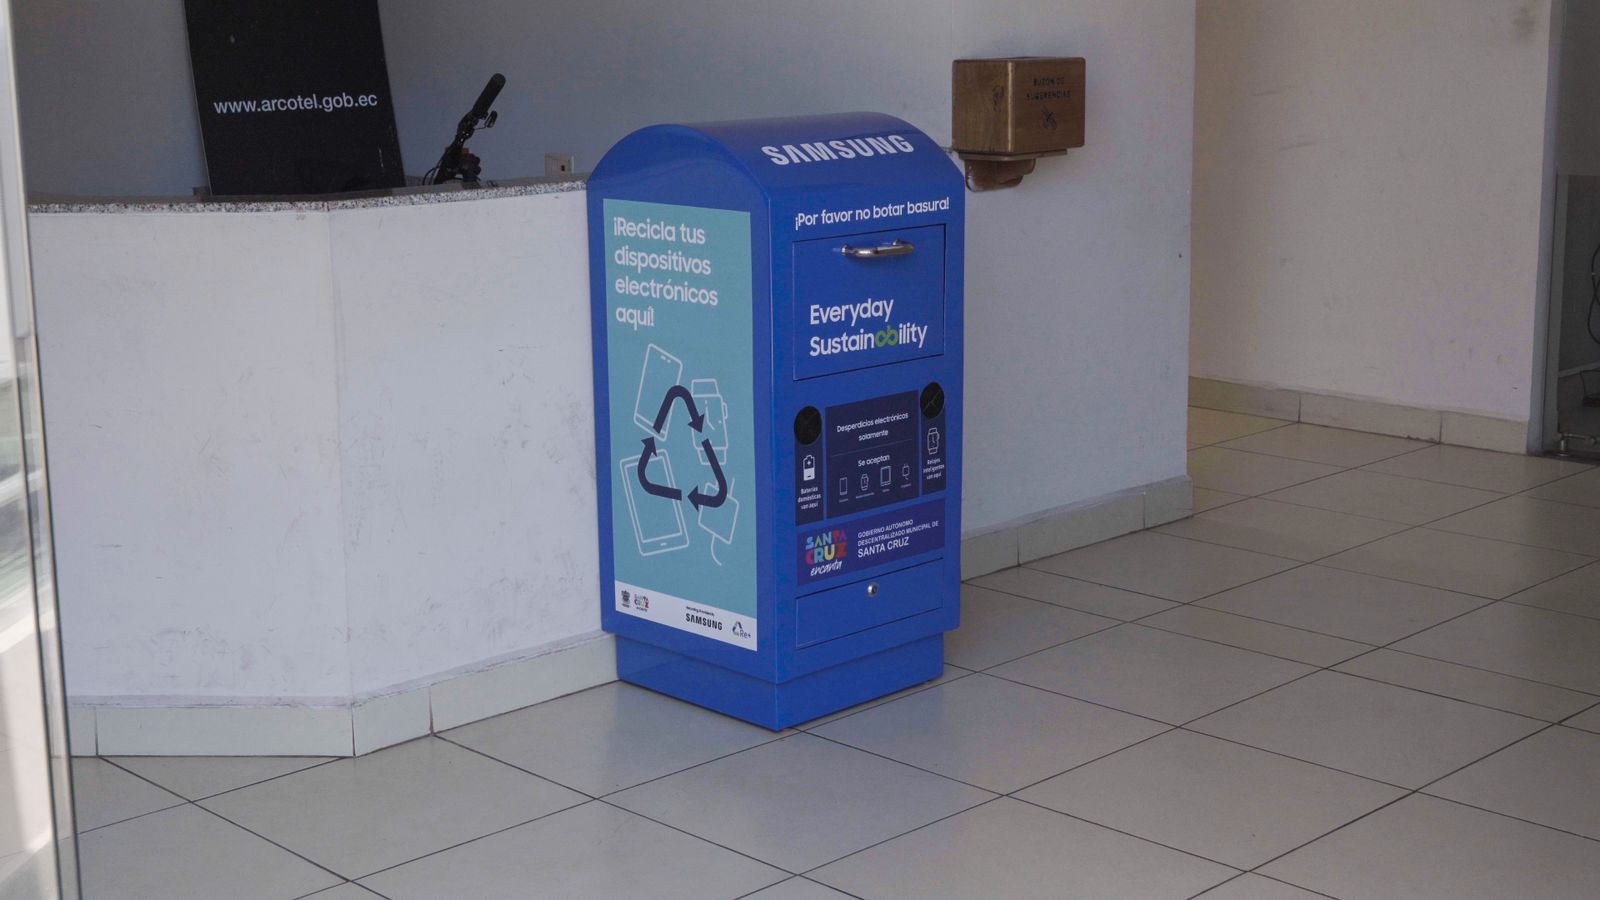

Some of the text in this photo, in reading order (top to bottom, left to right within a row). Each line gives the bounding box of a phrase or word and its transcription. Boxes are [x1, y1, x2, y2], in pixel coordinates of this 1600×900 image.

[213, 92, 378, 114] www.arcotel.gob.ec
[761, 134, 915, 166] SAMSUNG
[795, 197, 950, 231] ¡Por favor no botar basura!
[680, 223, 706, 245] tus
[614, 244, 712, 276] dispositivos
[615, 275, 719, 306] electrónicos
[615, 305, 655, 332] aquí!
[810, 298, 894, 327] Everyday
[809, 322, 928, 357] Sustainability
[836, 412, 909, 433] Desperdicios electrónicos
[858, 430, 889, 441] solamente
[866, 454, 891, 465] aceptan
[805, 529, 848, 550] SANTA
[857, 528, 885, 539] GOBIERNO
[857, 520, 940, 547] DESCENTRALIZADO MUNICIPAL DE
[804, 542, 848, 567] CRUZ
[857, 536, 910, 558] SANTA CRUZ
[686, 612, 723, 631] SAMSUNG
